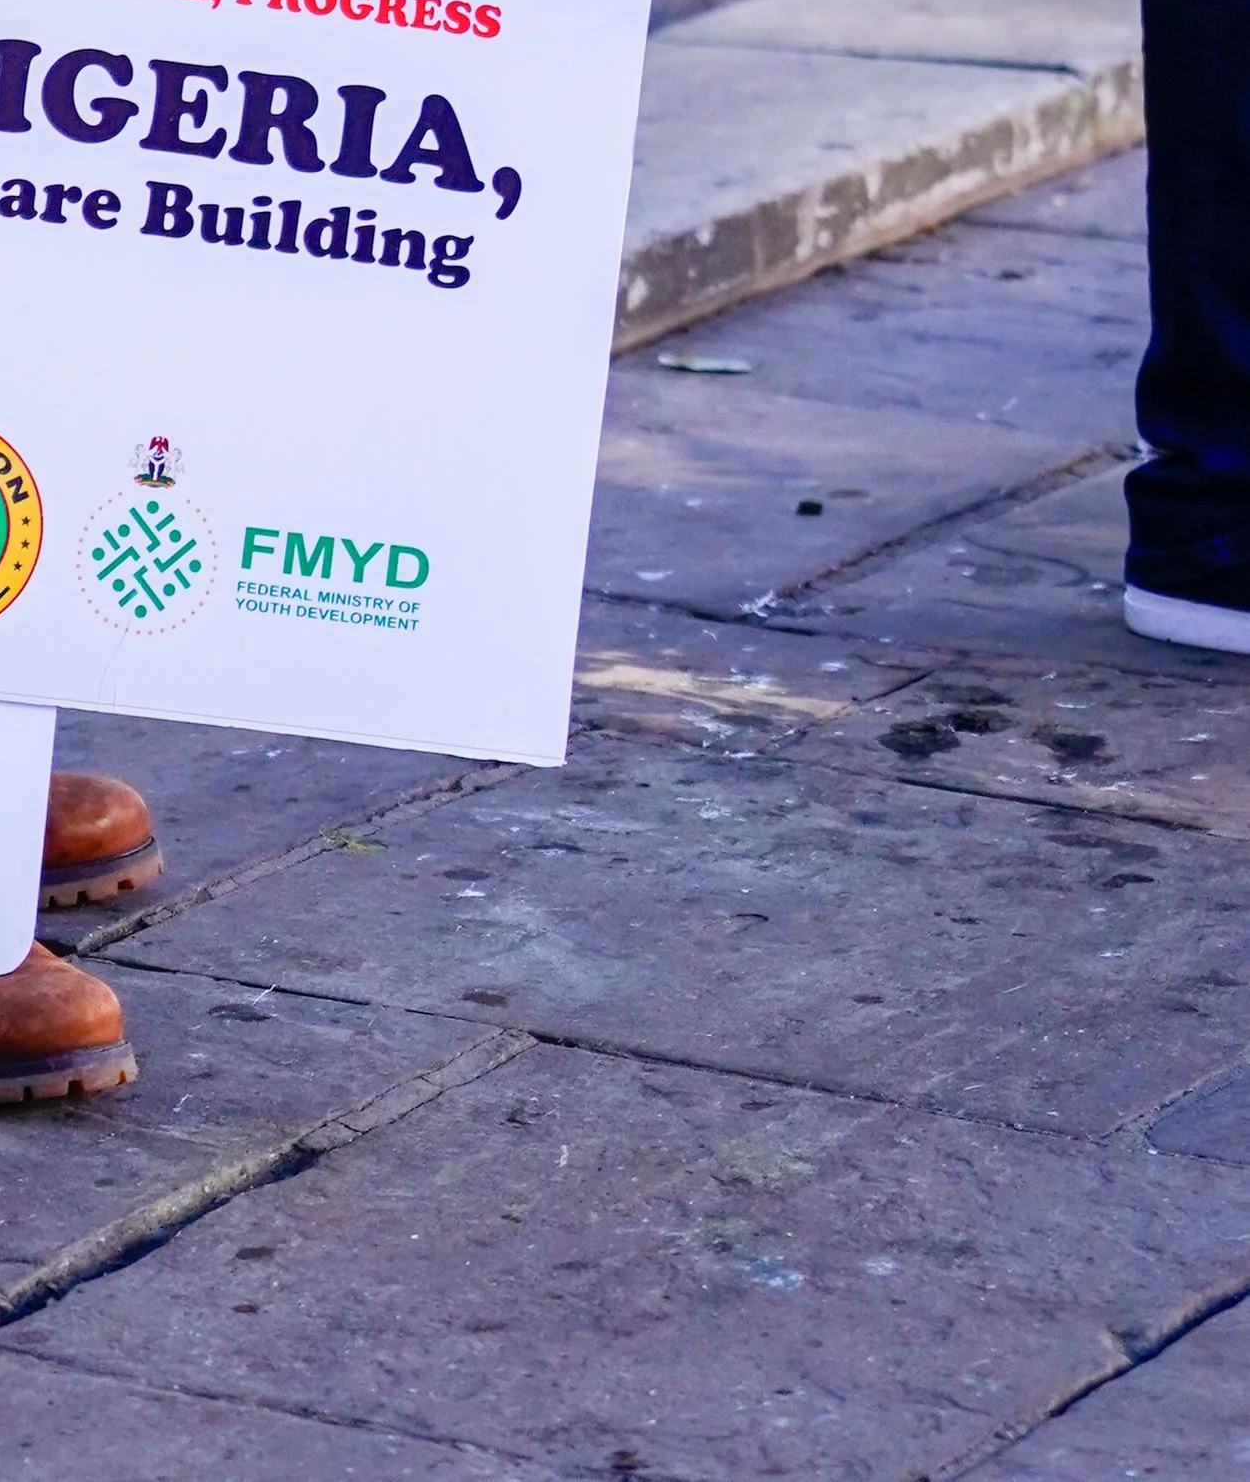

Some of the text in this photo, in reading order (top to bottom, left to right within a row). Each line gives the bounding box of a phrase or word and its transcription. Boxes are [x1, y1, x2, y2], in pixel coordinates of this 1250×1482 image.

[140, 181, 474, 288] Building
[241, 527, 430, 590] FMYD
[236, 581, 421, 614] FEDERAL MINISTRY OF
[236, 597, 420, 631] YOUTH DEVELOPMENT
